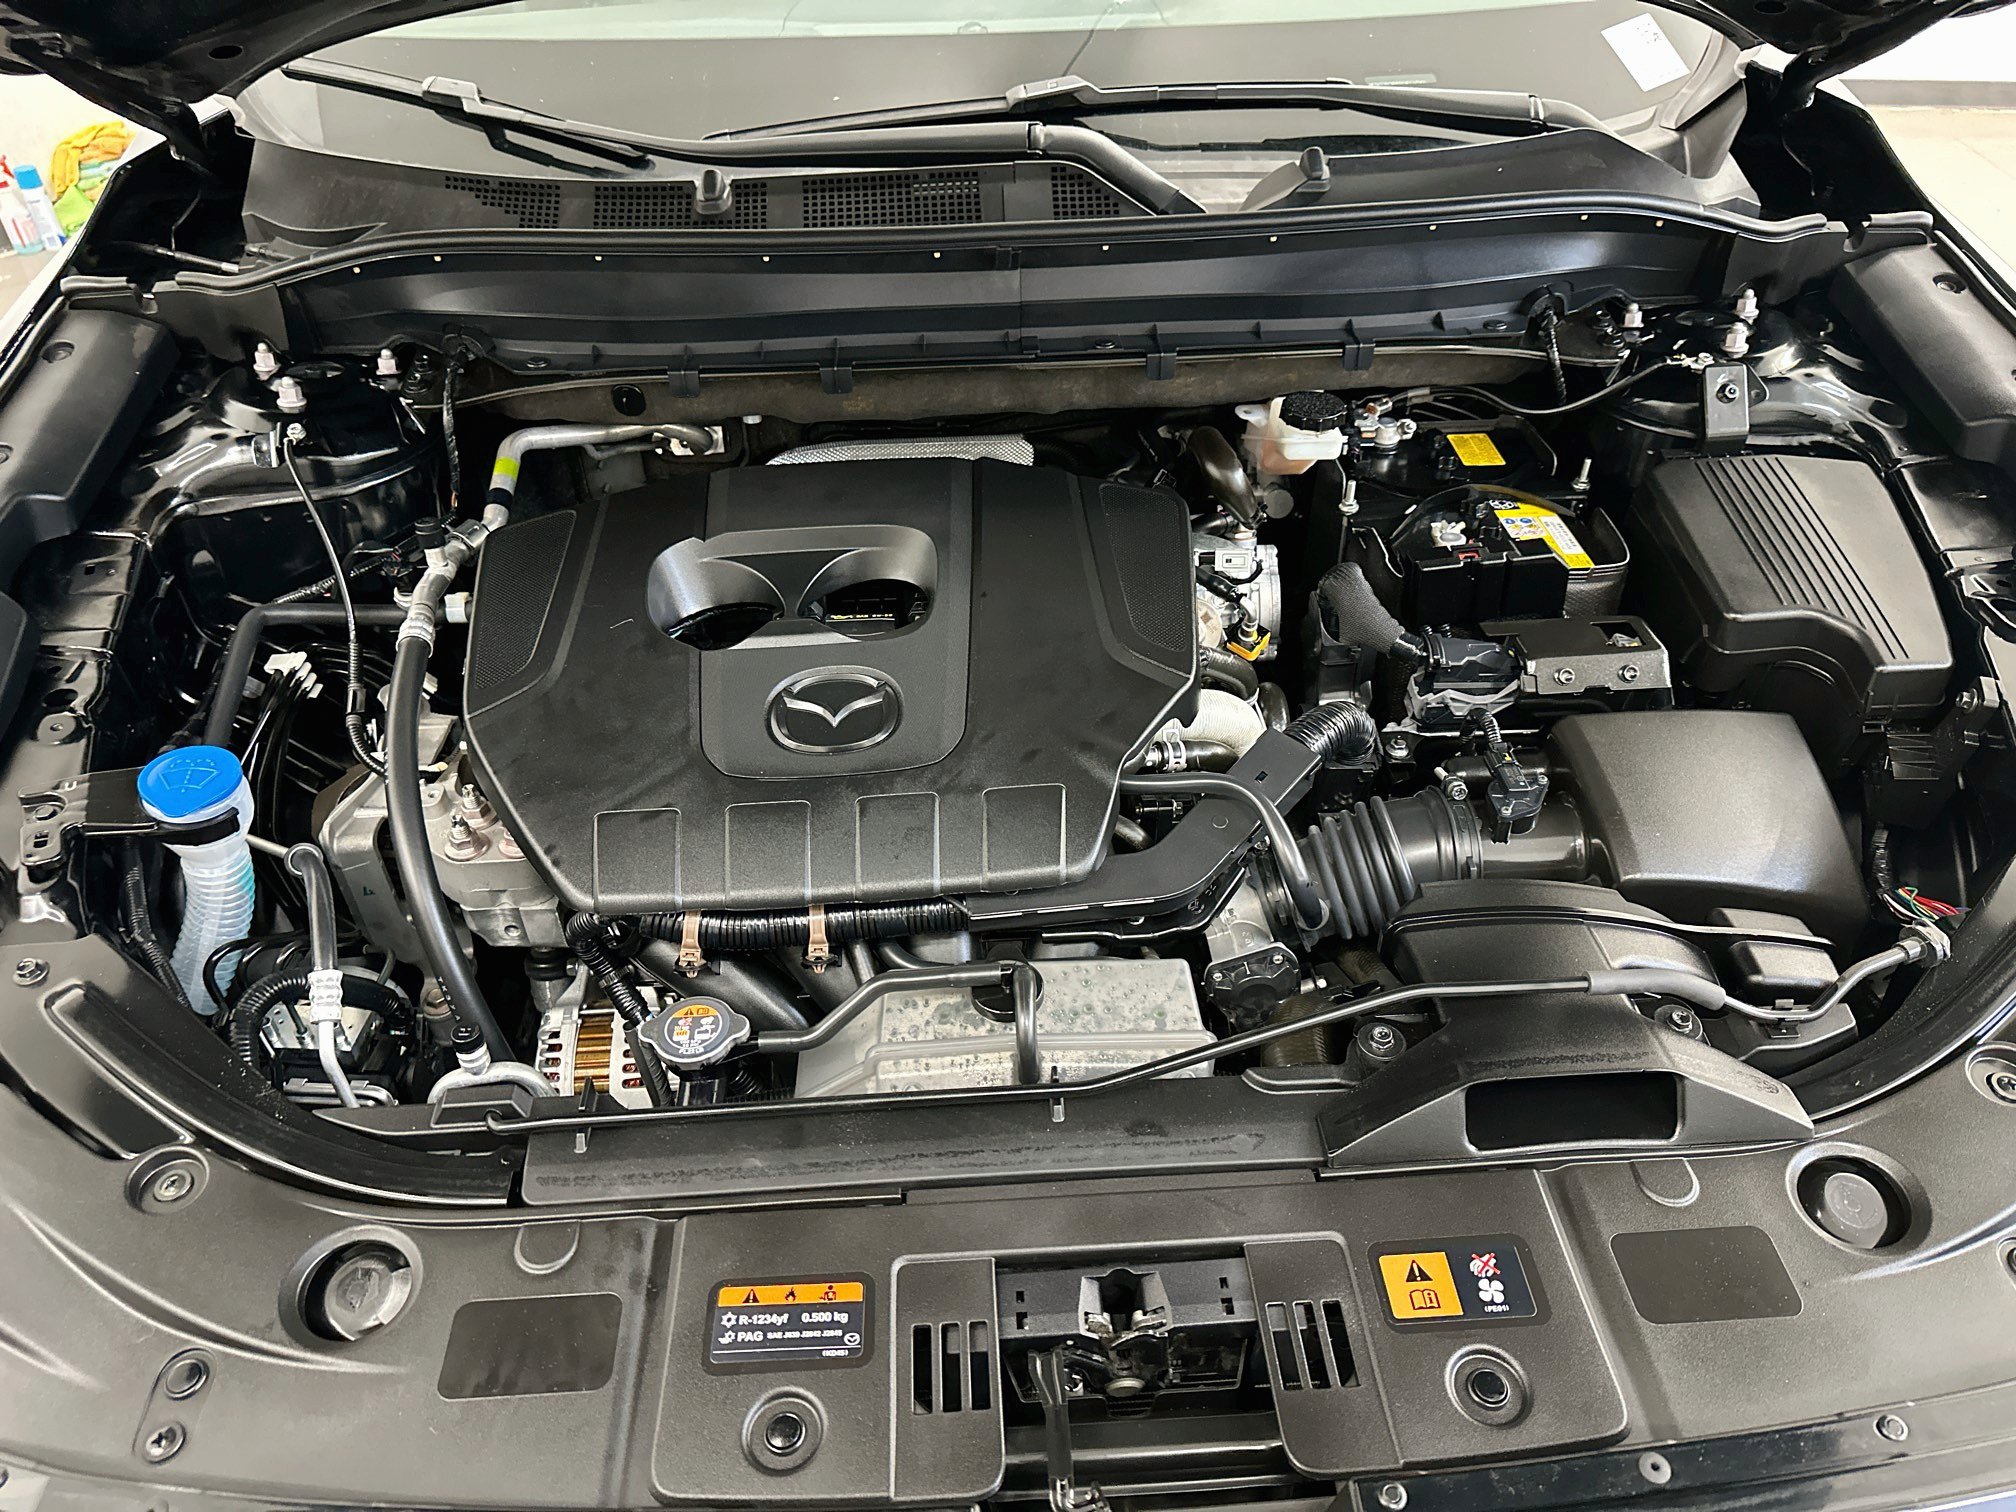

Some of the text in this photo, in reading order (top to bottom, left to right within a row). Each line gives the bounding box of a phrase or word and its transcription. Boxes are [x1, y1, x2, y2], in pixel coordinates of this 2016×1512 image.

[738, 1311, 849, 1327] R-1234yf 0.500 kg
[737, 1331, 764, 1342] PAG
[767, 1331, 783, 1339] SAE
